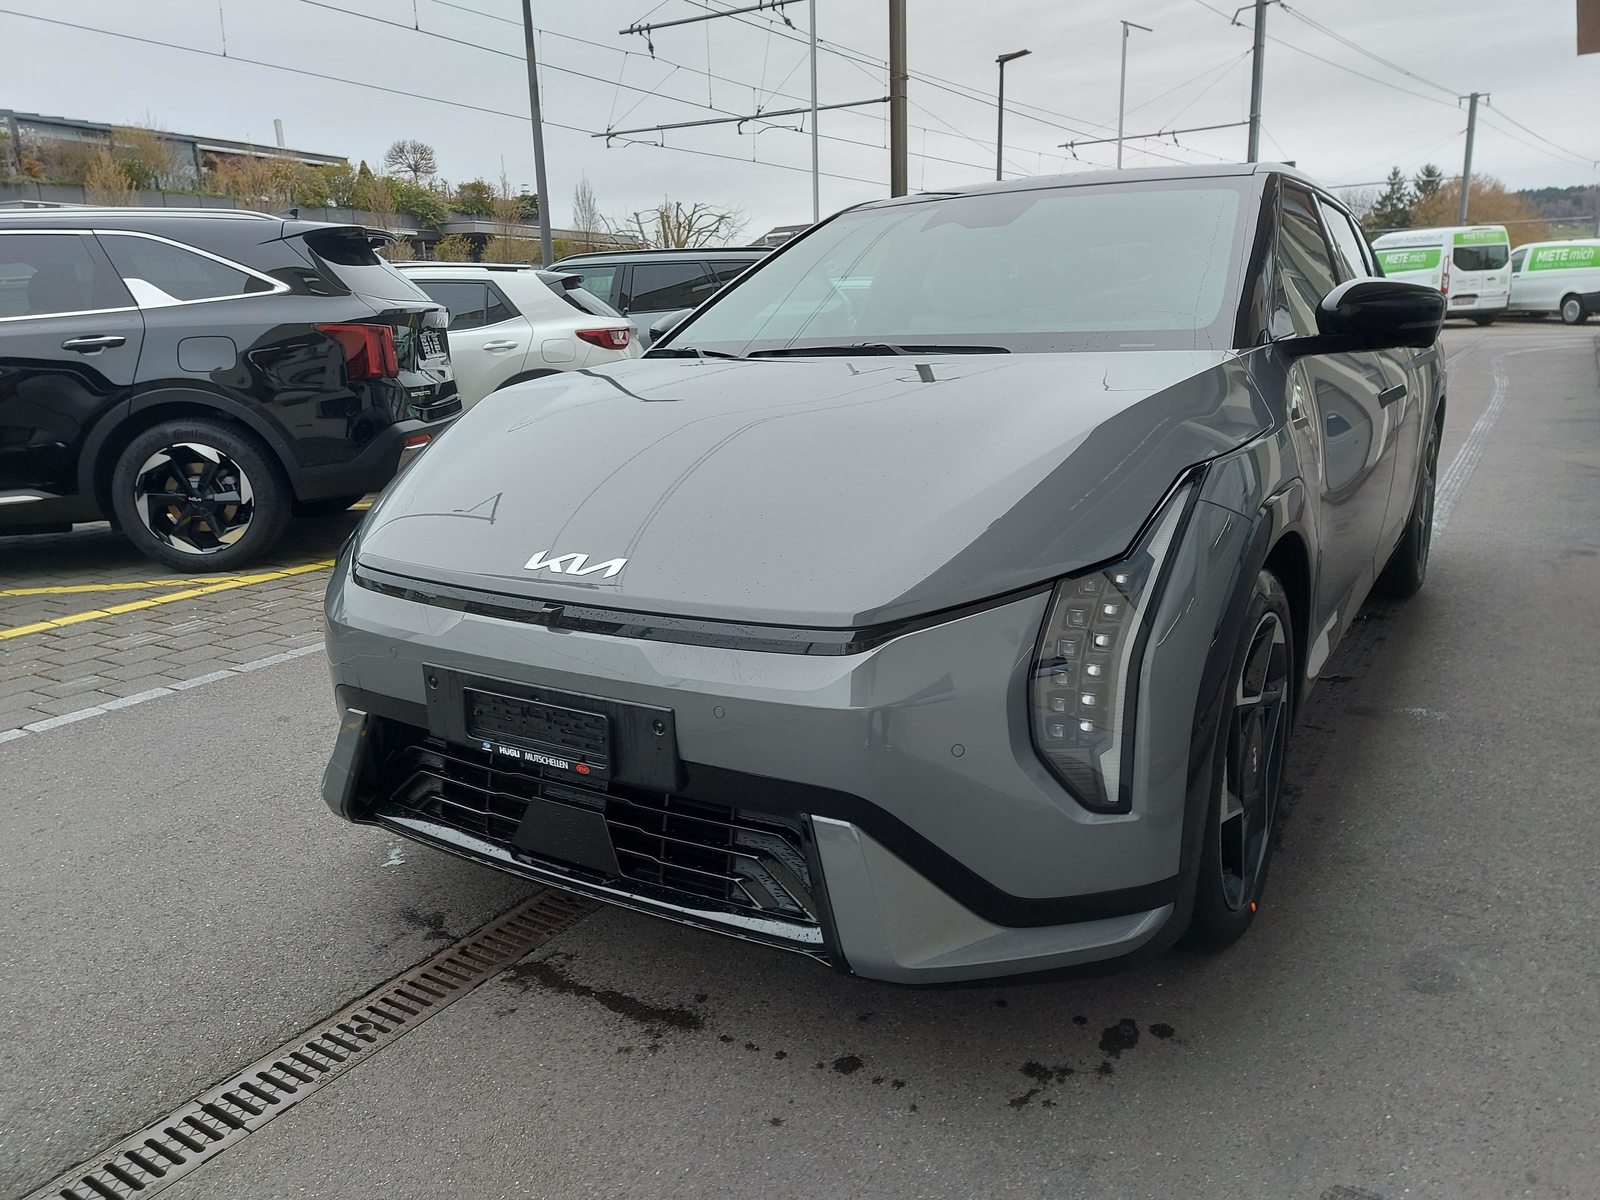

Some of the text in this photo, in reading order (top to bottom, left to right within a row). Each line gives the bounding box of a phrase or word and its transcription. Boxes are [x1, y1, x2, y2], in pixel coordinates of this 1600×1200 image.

[1385, 251, 1426, 264] MIETE mich
[1536, 247, 1594, 262] MIETE mich
[524, 549, 629, 579] KIA
[524, 752, 568, 769] MUTSCHELLEN
